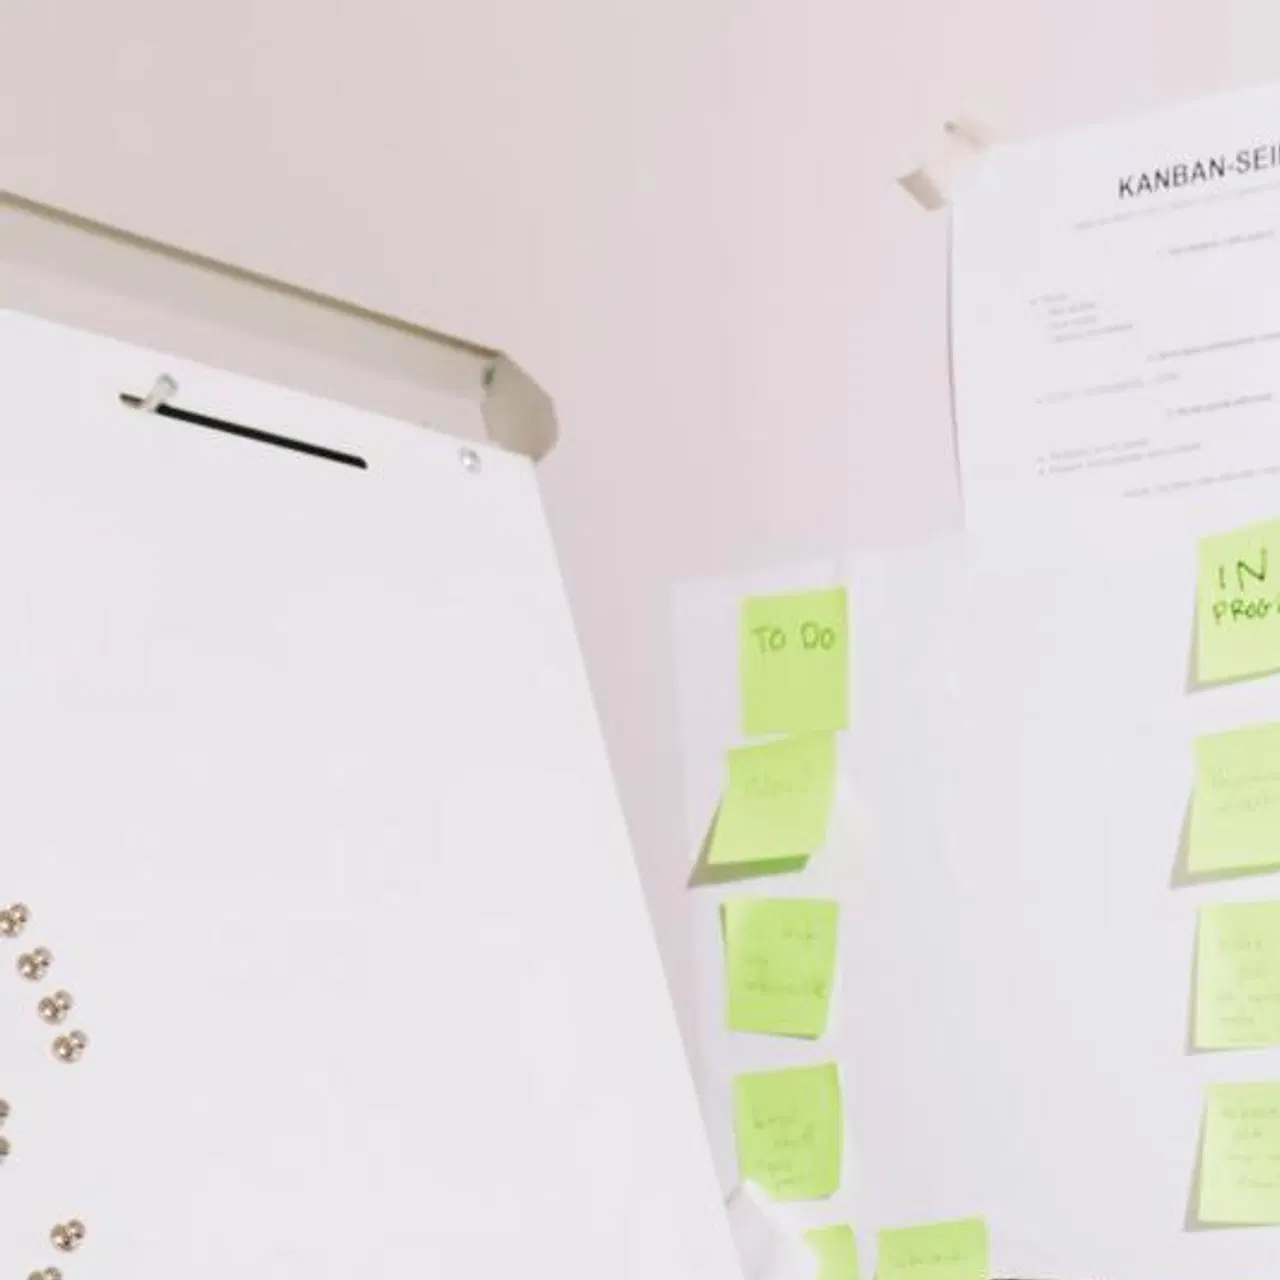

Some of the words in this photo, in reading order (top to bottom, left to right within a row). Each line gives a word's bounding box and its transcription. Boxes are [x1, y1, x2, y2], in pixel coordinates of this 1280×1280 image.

[1217, 546, 1270, 592] IN
[750, 626, 786, 653] TO
[800, 620, 835, 651] DO
